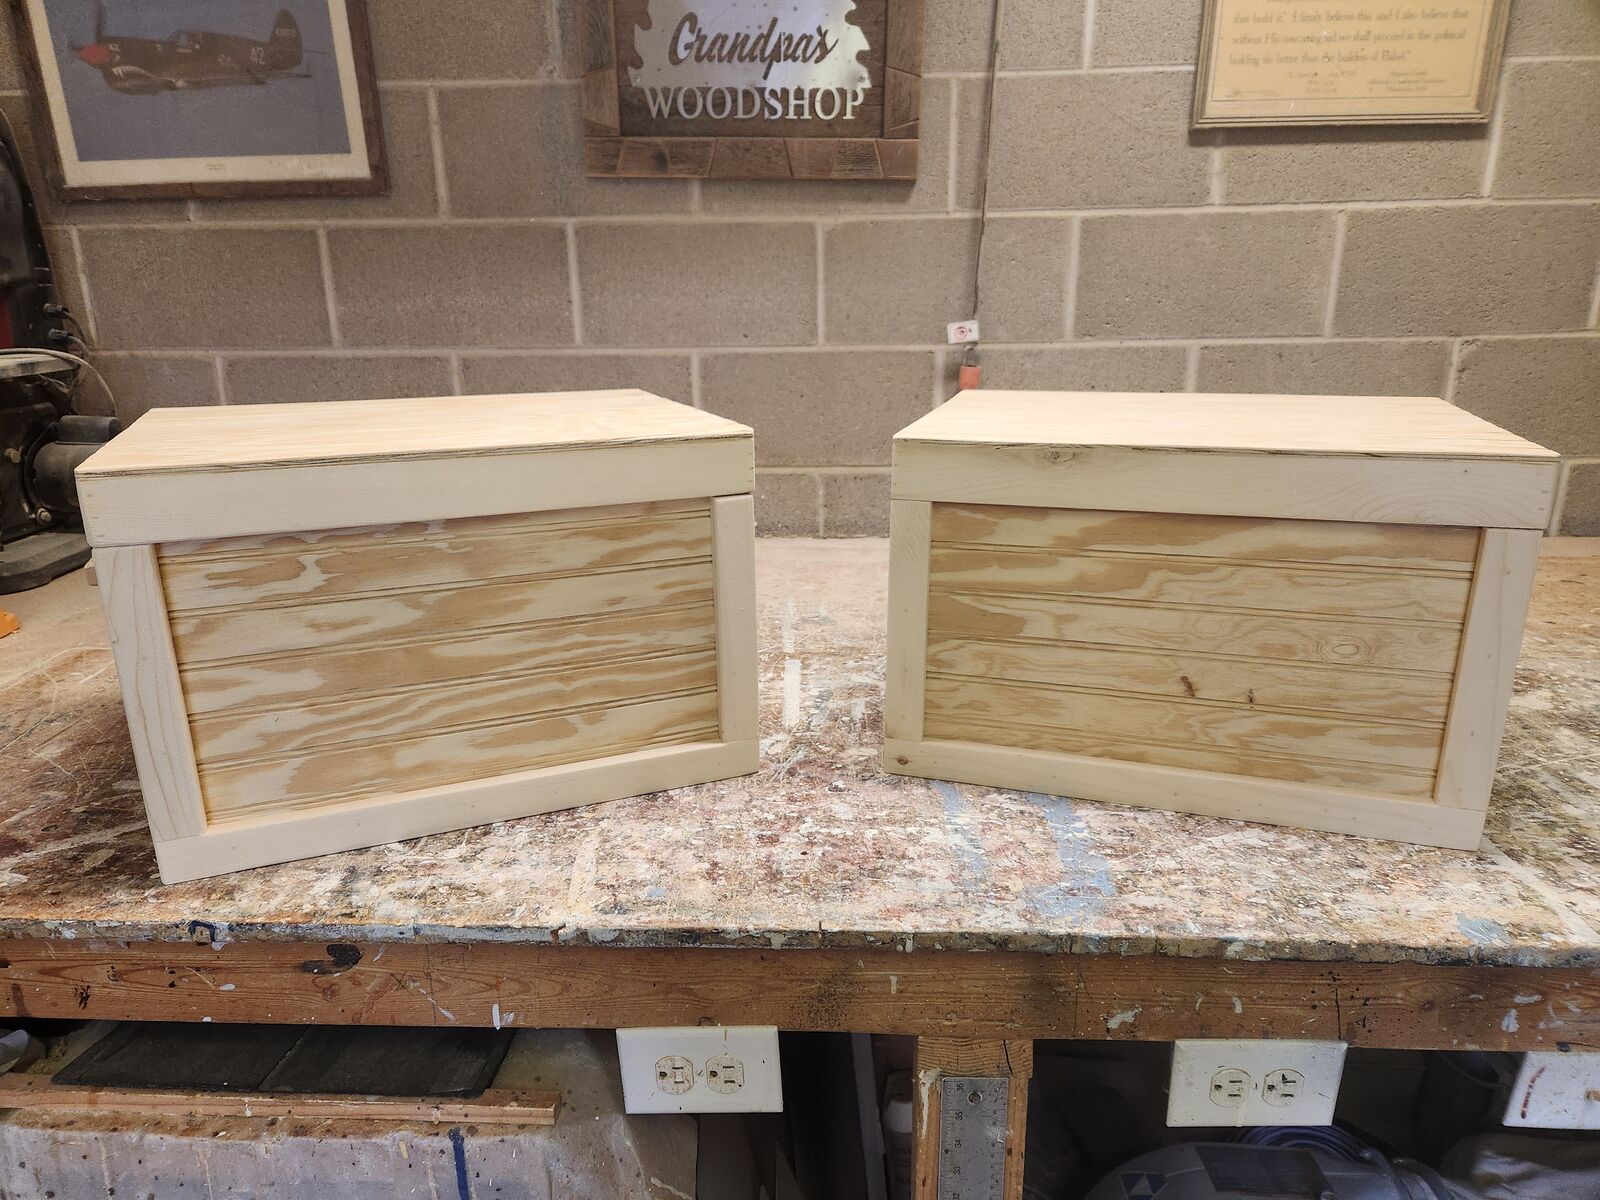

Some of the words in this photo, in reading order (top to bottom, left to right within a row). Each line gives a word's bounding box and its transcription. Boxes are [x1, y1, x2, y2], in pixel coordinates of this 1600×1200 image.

[643, 86, 865, 120] WOODSHOP
[956, 1083, 964, 1092] 36
[955, 1111, 963, 1120] 35
[954, 1139, 962, 1148] 34
